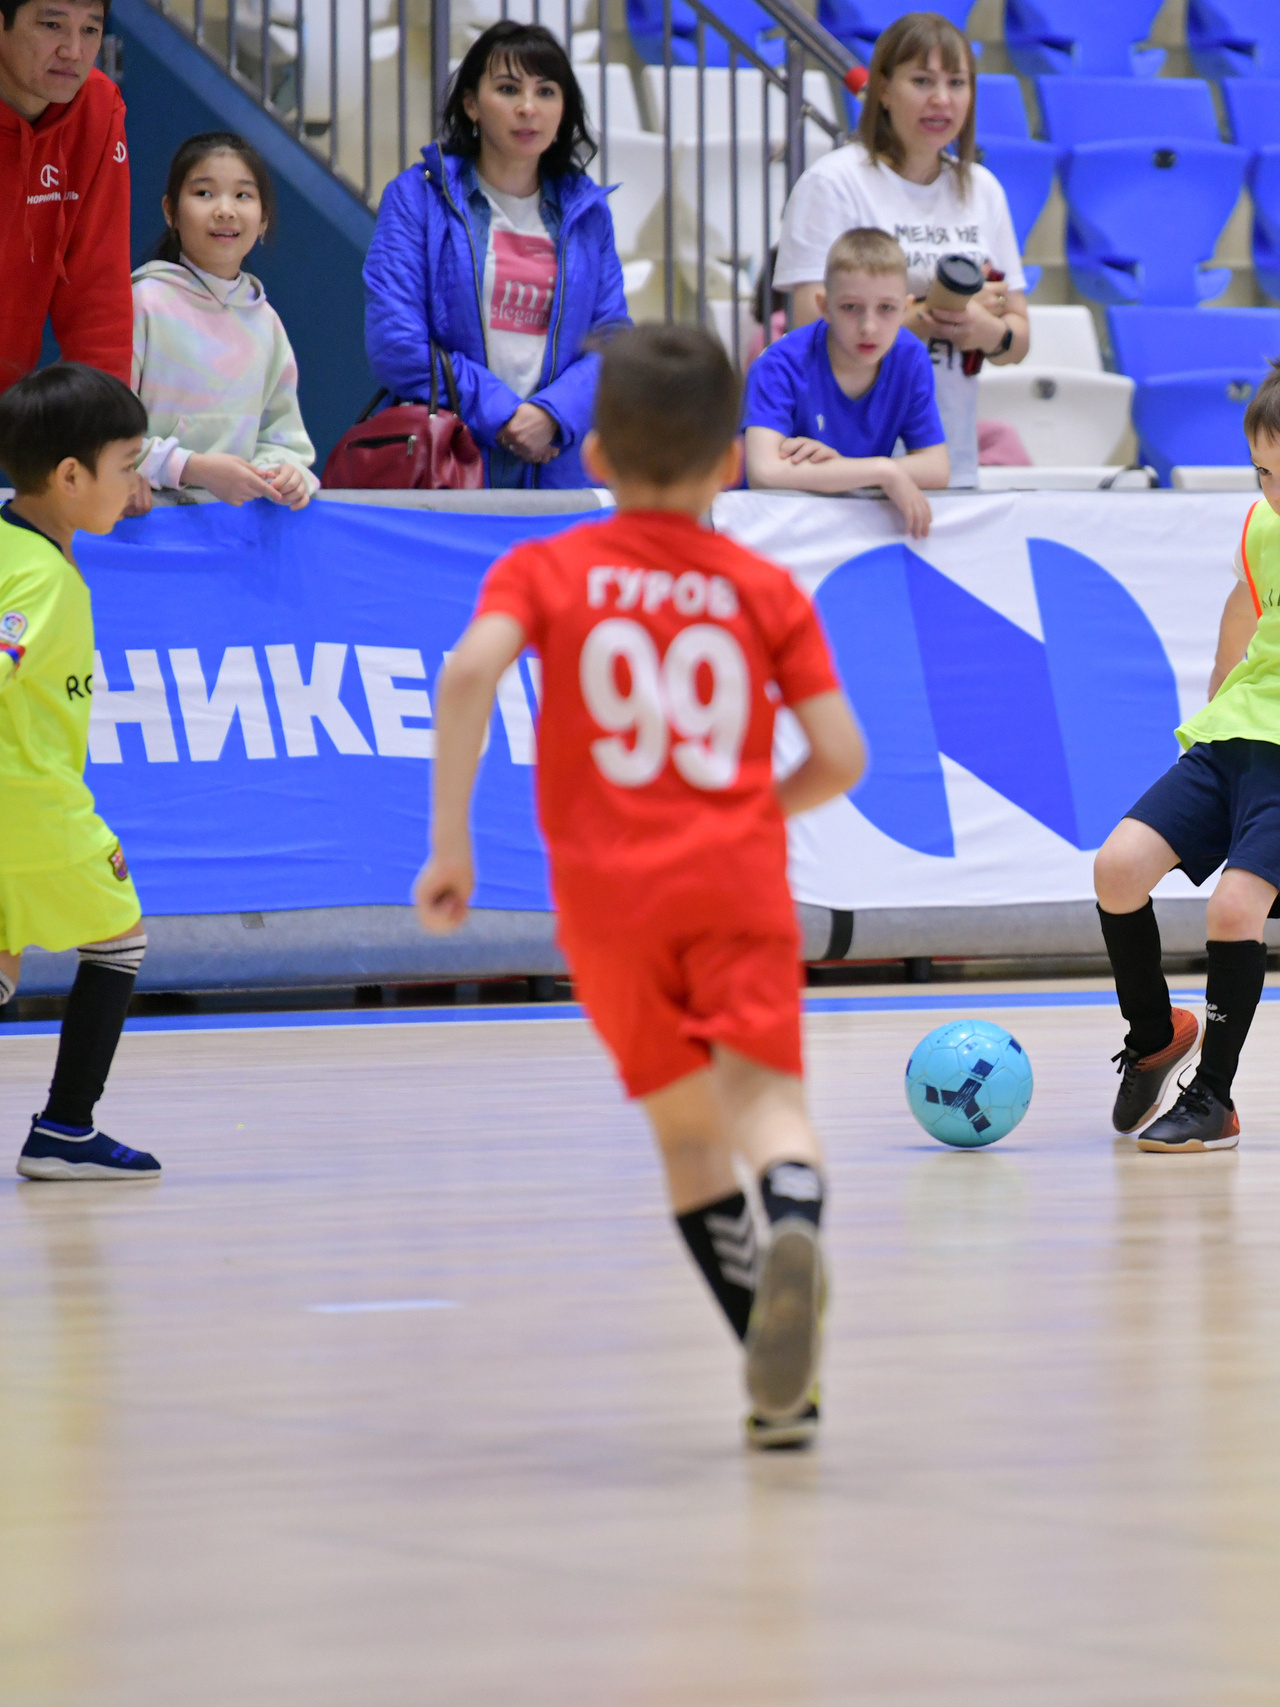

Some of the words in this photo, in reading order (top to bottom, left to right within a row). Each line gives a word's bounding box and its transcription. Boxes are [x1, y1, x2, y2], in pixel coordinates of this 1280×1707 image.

[895, 223, 950, 245] МЕНЯ
[586, 564, 740, 620] ГУРОВ
[579, 616, 750, 790] 99
